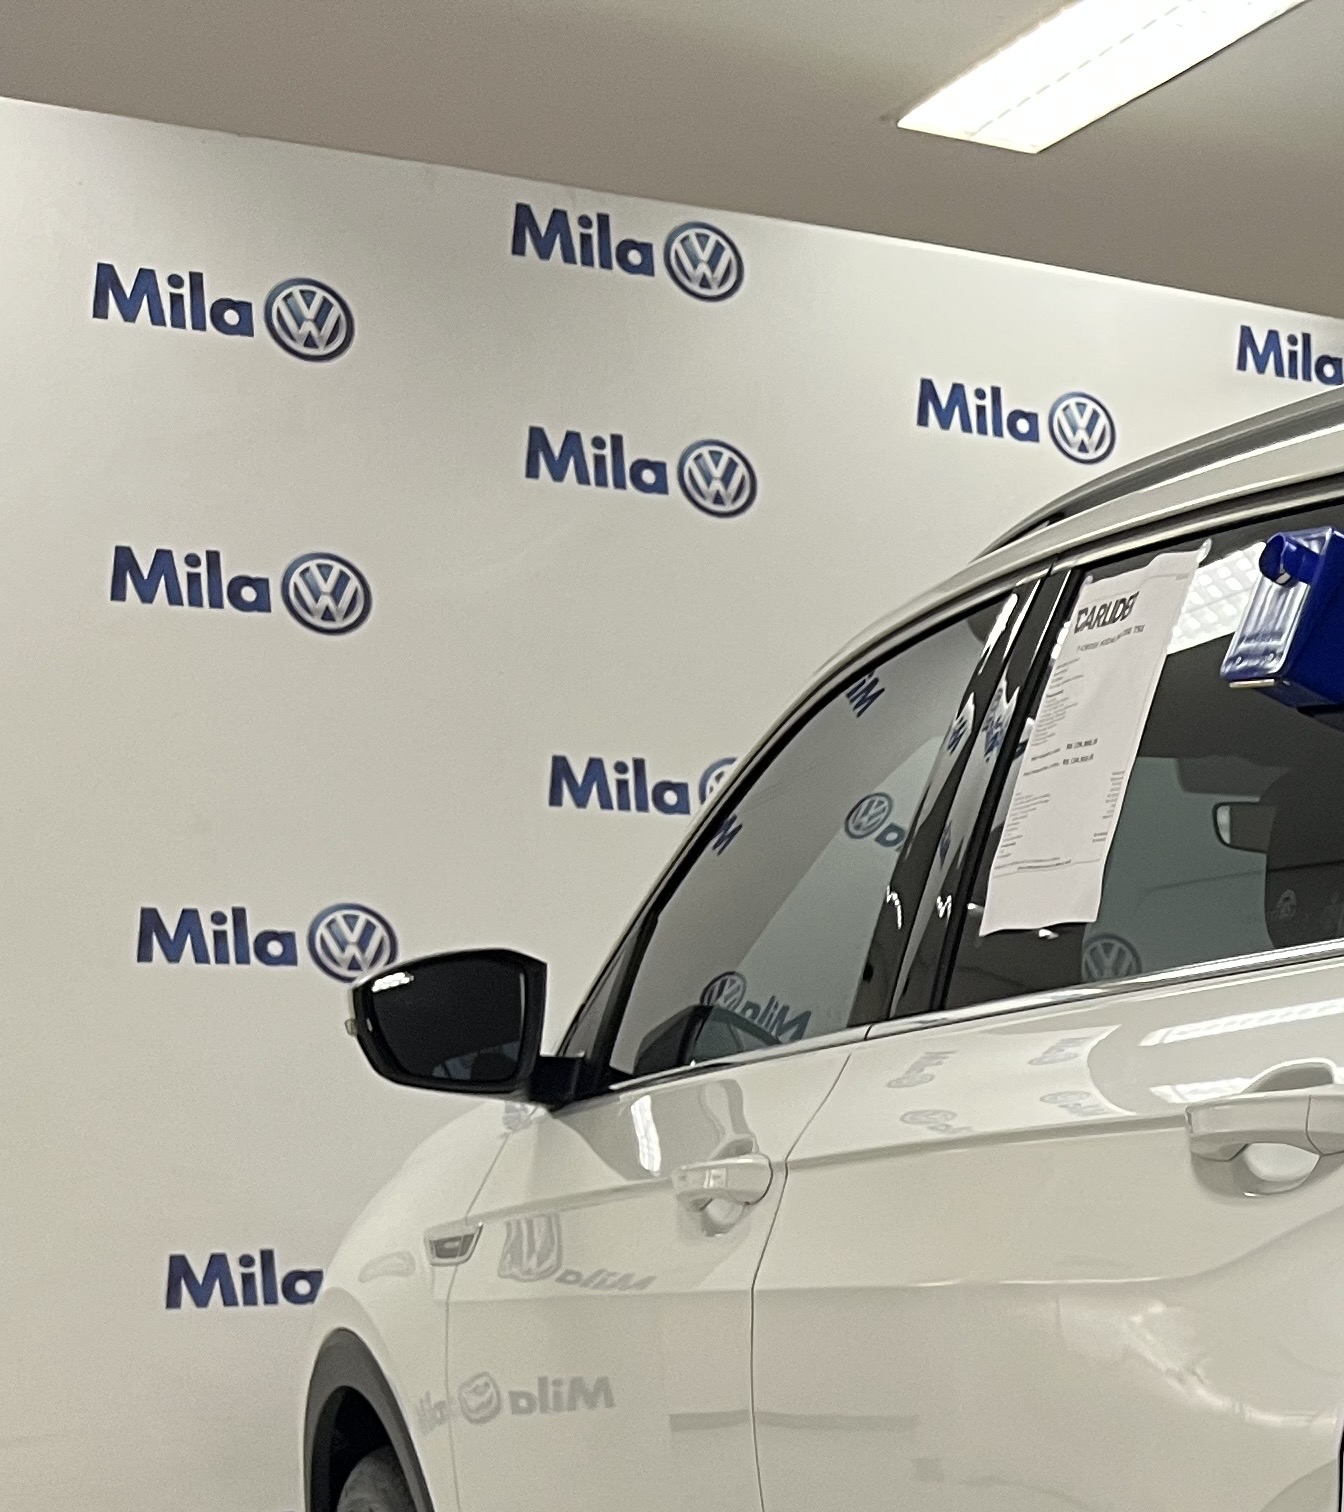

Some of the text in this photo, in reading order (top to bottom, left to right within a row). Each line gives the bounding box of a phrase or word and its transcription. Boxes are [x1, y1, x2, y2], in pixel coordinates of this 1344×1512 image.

[511, 201, 656, 278] Mila
[92, 262, 255, 337] Mila
[1236, 325, 1344, 386] Mila
[916, 377, 1041, 445] Mila
[525, 424, 669, 496] Mila
[110, 545, 272, 614] Mila
[548, 755, 691, 816] Mila
[136, 906, 299, 970] Mila
[164, 1249, 323, 1310] Mila
